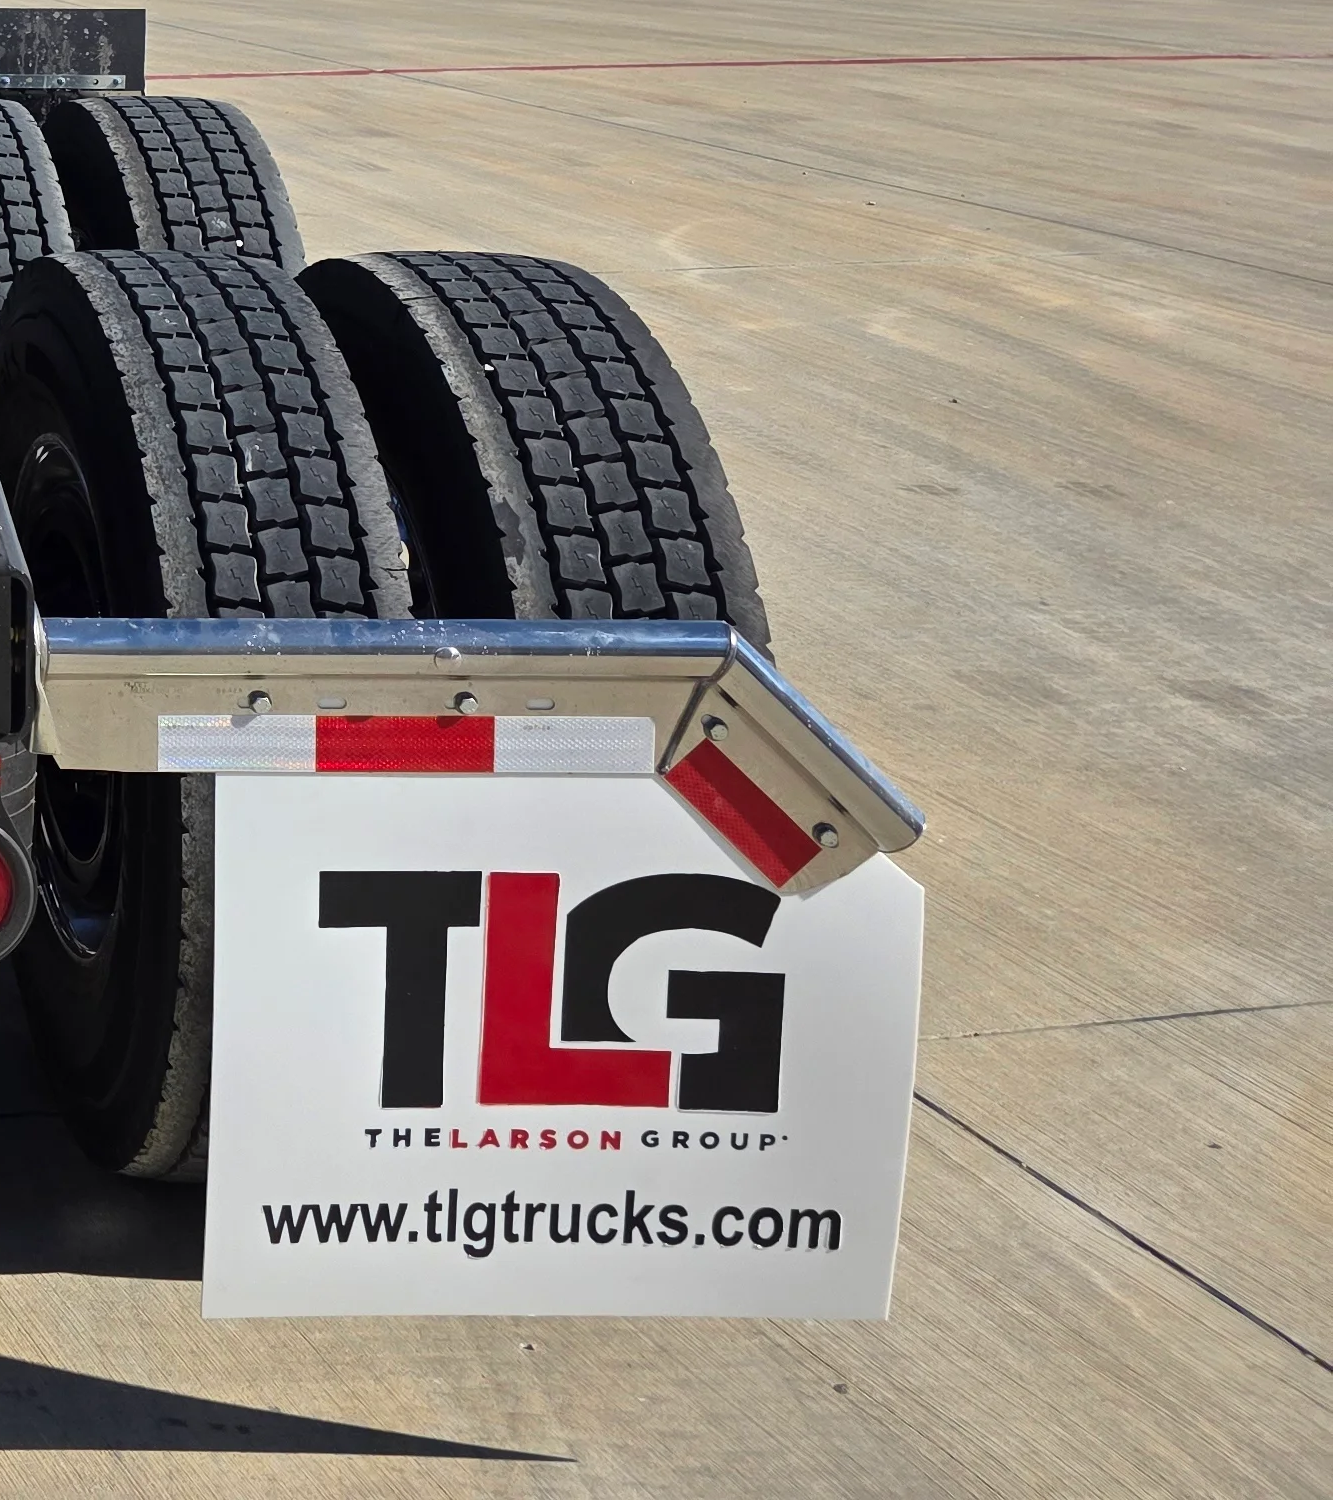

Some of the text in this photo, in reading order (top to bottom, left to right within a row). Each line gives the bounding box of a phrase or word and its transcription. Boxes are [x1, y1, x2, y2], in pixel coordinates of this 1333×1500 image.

[318, 871, 786, 1113] TLG
[640, 1129, 775, 1152] GROUP
[262, 1188, 842, 1258] www.tlgtrucks.com
